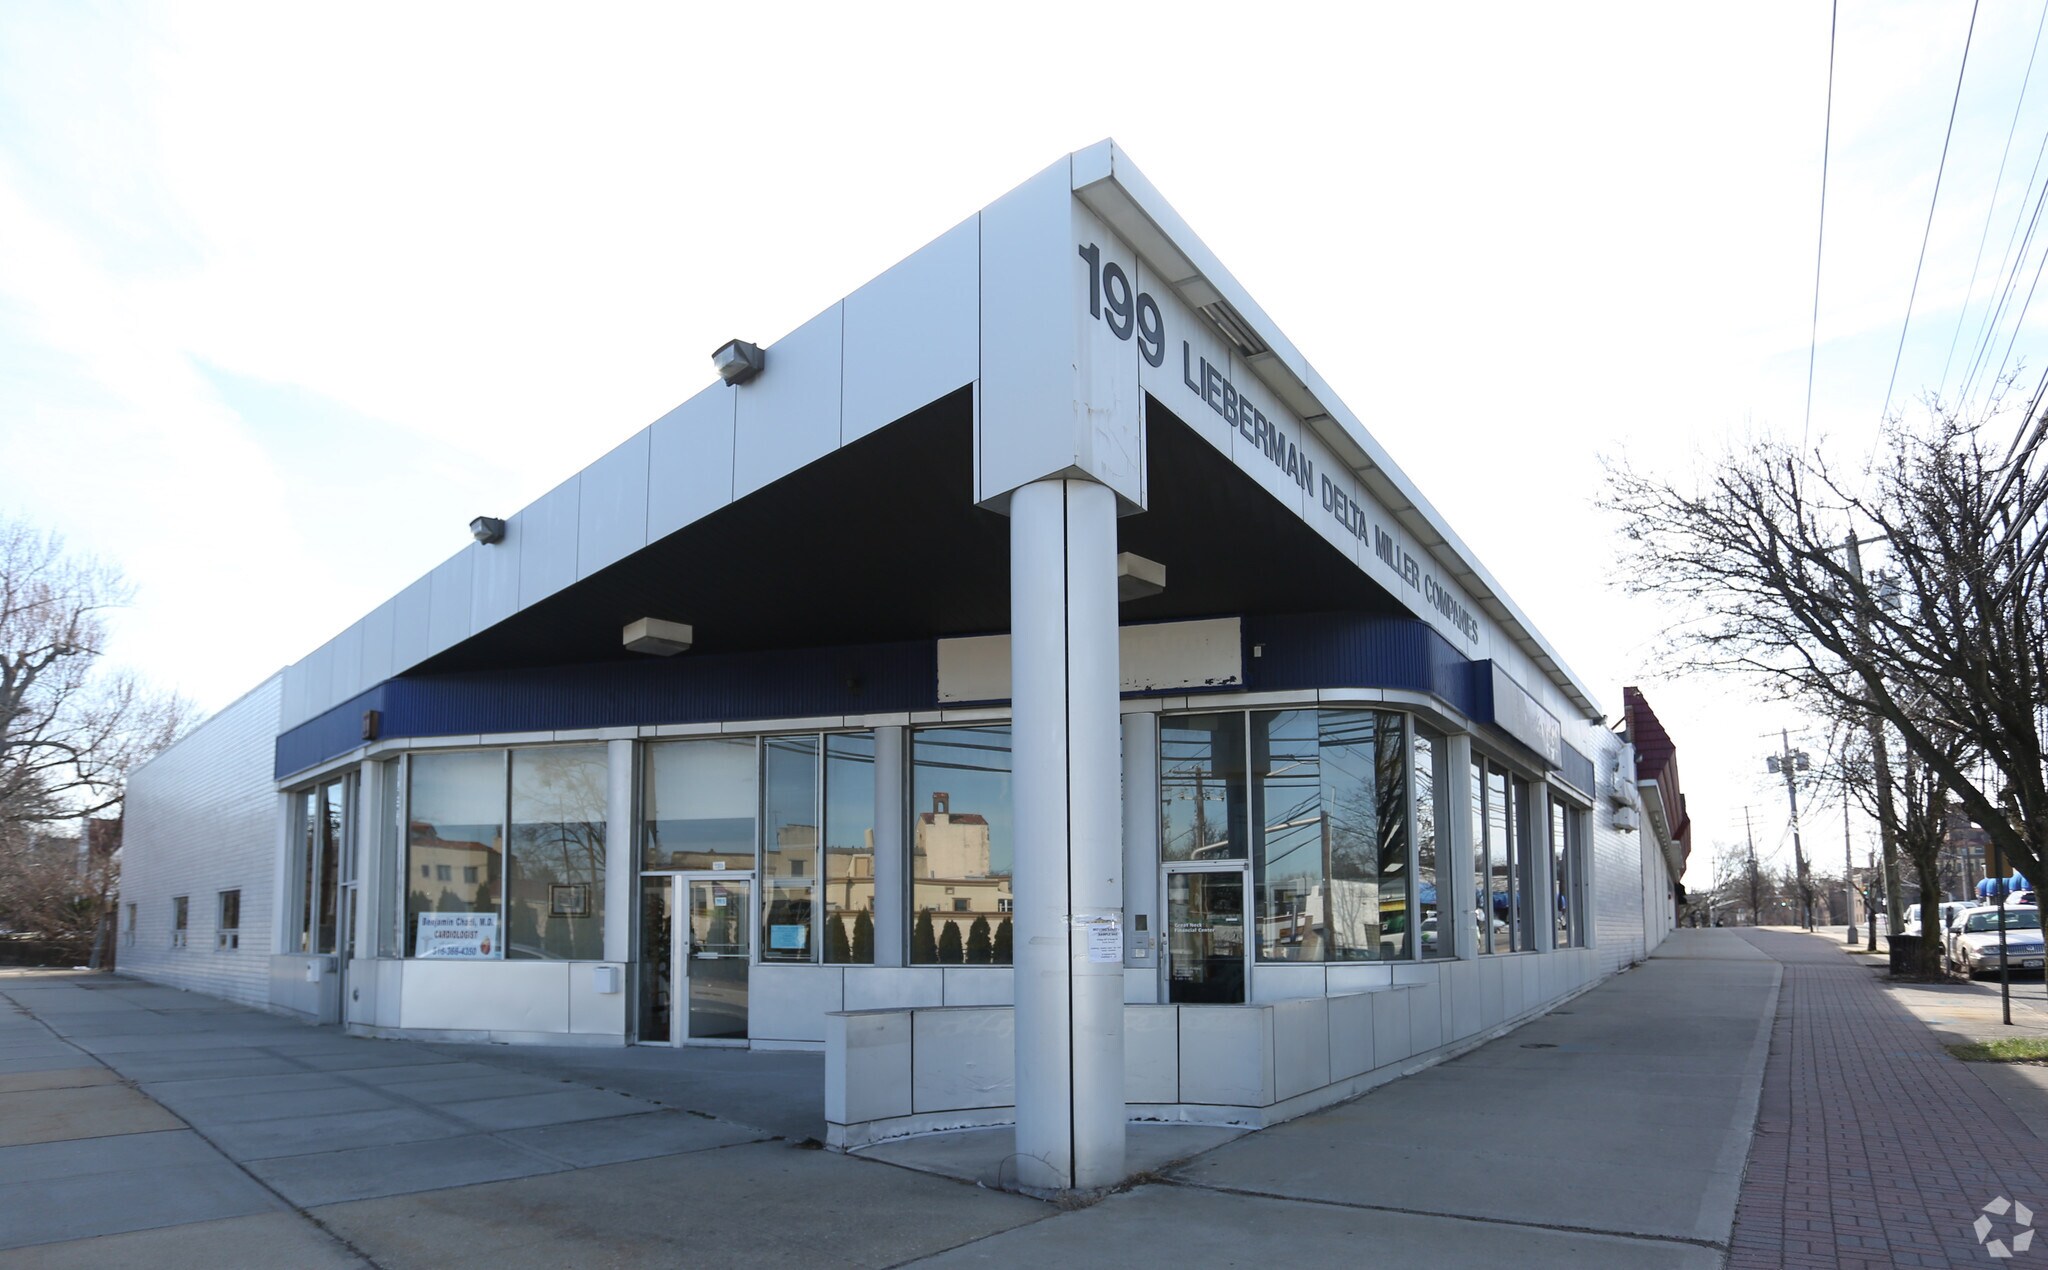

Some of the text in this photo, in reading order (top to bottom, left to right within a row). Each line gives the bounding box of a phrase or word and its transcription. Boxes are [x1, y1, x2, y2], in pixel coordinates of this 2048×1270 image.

[1078, 242, 1479, 646] 199 LIEBERMAN DELTA MILLER COMPANIES
[434, 930, 478, 939] CARDIOLOGIST
